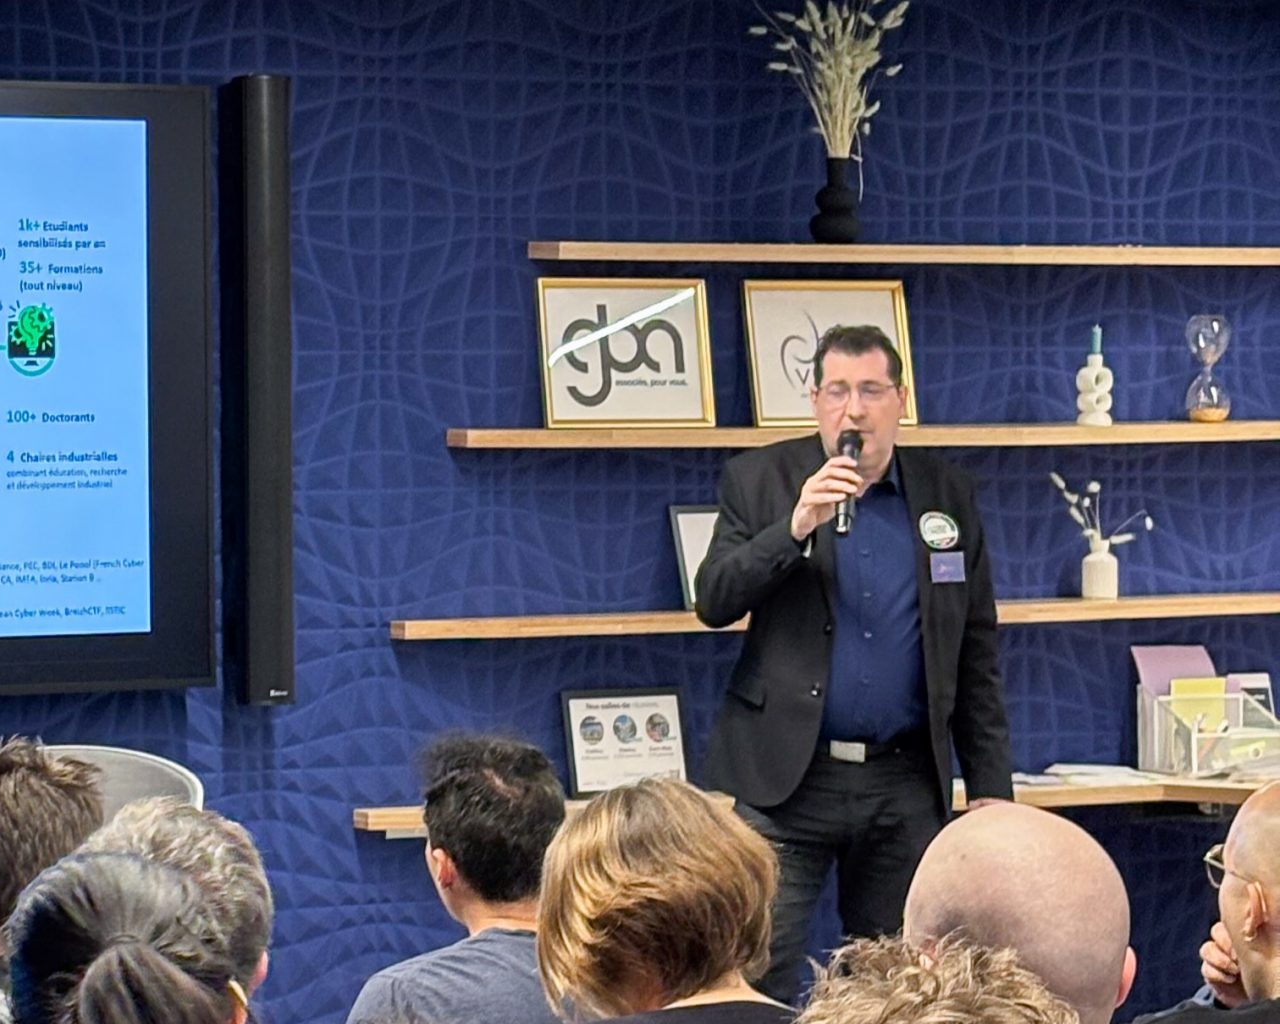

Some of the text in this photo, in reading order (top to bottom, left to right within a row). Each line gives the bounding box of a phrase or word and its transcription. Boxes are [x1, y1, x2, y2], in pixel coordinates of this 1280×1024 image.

[19, 218, 89, 232] 1k+ Etudiants
[18, 237, 72, 248] sensibilisés
[75, 239, 91, 250] par
[19, 261, 103, 275] 35+ Formations
[20, 280, 83, 293] (tout niveau)
[7, 411, 95, 423] 100+ Doctorants
[7, 451, 118, 462] 4 Chaires industrielles
